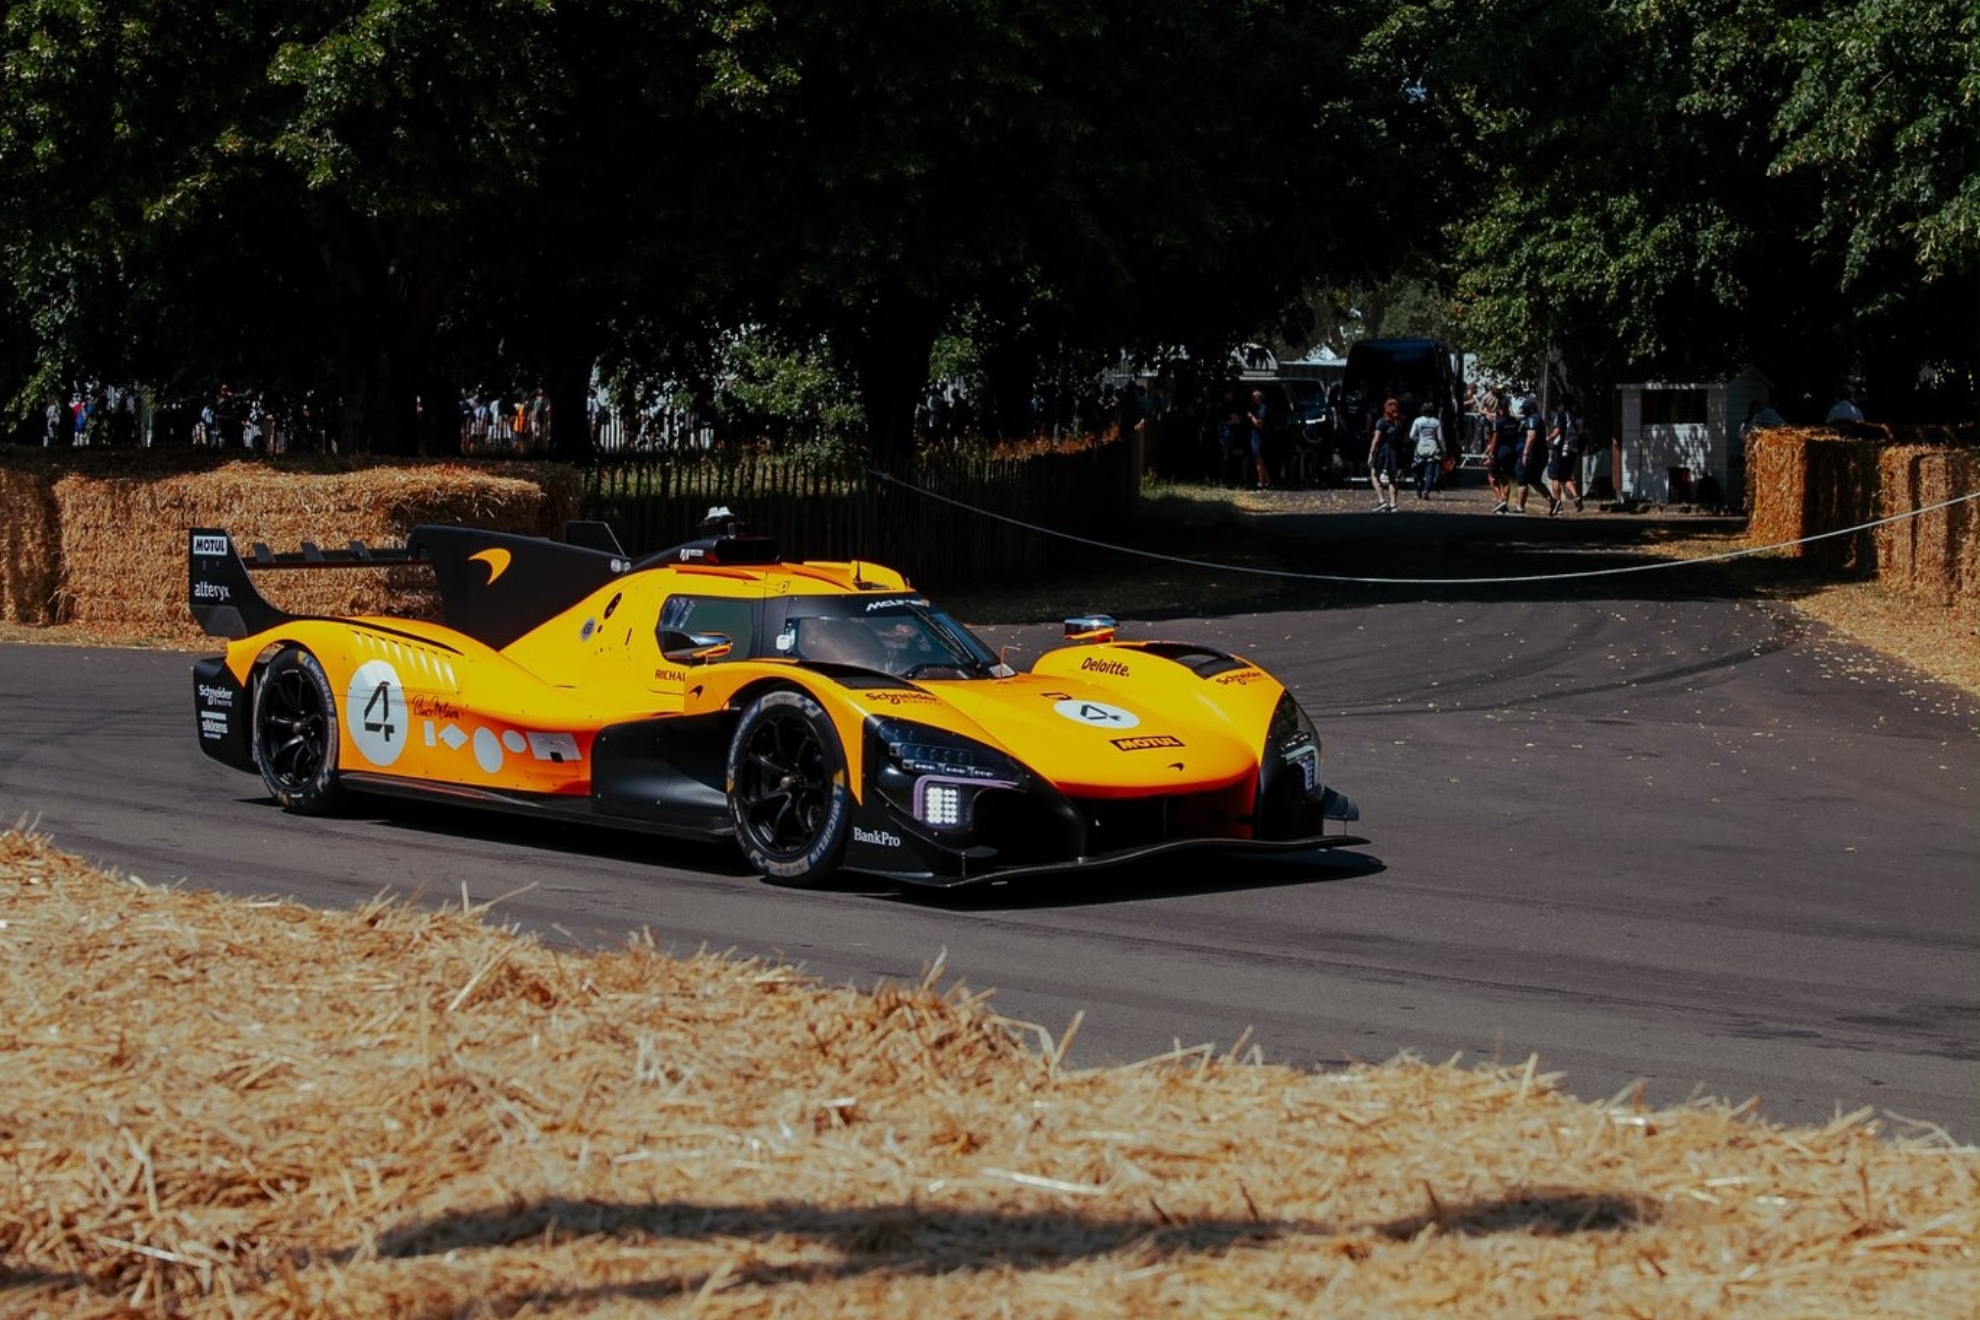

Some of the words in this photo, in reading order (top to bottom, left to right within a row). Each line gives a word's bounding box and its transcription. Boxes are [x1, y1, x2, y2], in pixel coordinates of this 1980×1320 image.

[195, 539, 225, 552] MOTUL
[194, 581, 231, 601] alteryx
[1082, 657, 1129, 677] Deloitte.
[199, 685, 232, 700] Schneider
[363, 681, 395, 743] 4
[1080, 704, 1122, 722] 4
[1117, 737, 1179, 749] MOTUL
[810, 799, 840, 863] MICHELIN
[853, 826, 901, 847] BankPro
